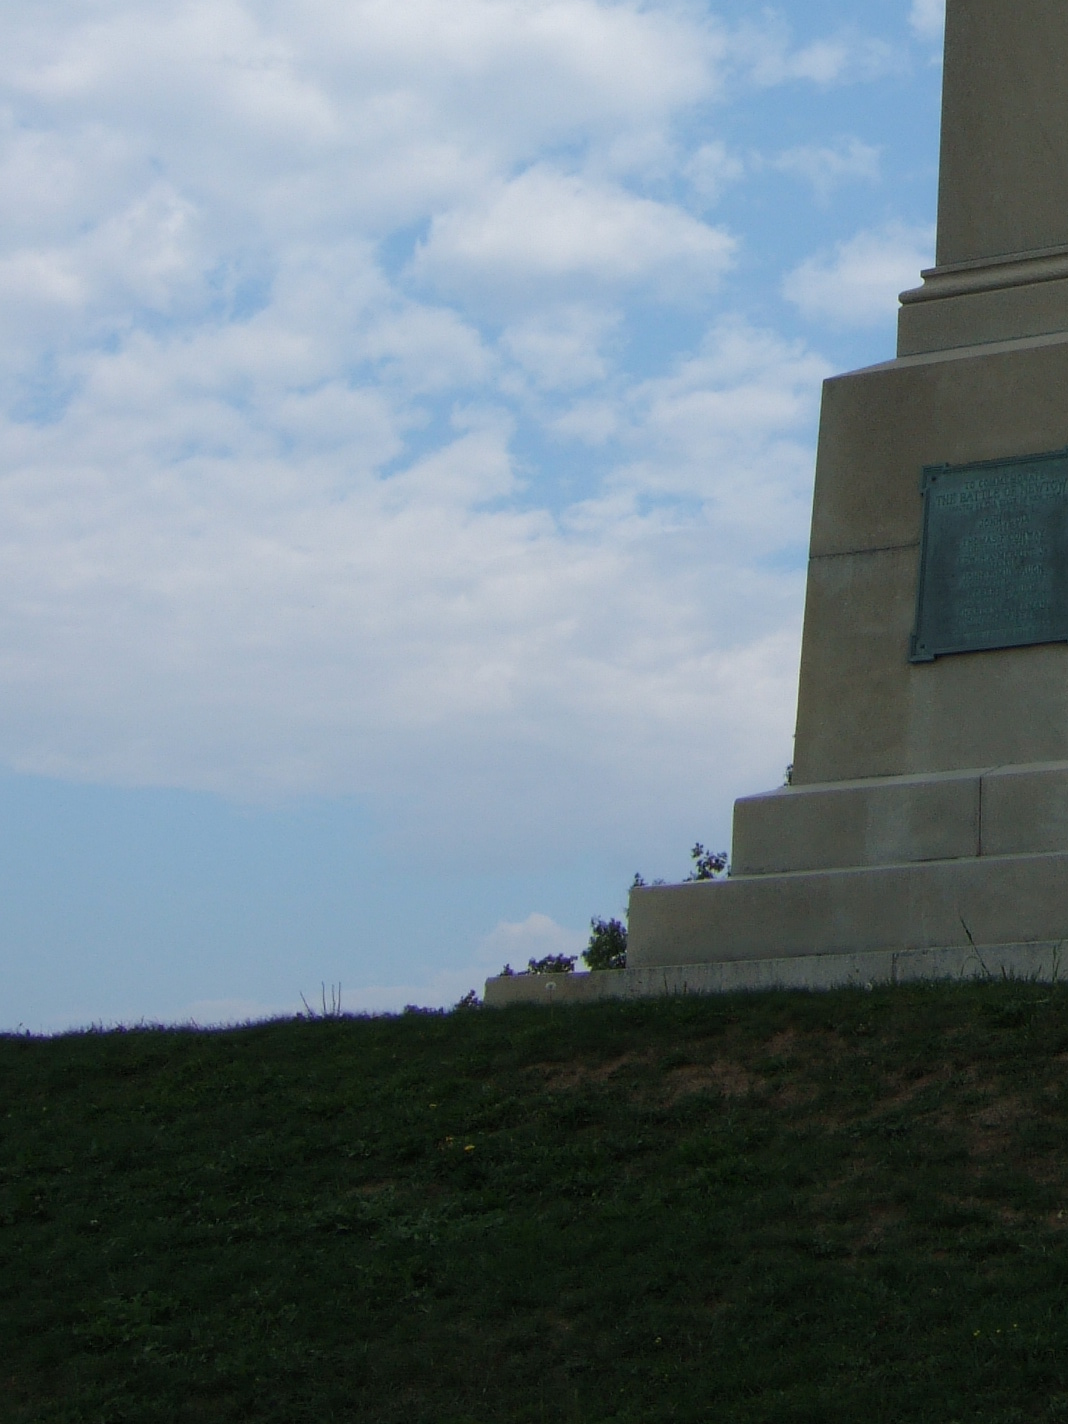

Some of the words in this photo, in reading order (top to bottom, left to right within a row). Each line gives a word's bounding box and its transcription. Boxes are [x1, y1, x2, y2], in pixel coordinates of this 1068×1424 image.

[964, 480, 975, 490] TO
[936, 492, 956, 507] THE
[959, 487, 1000, 504] BATTLE
[1004, 485, 1016, 496] OF
